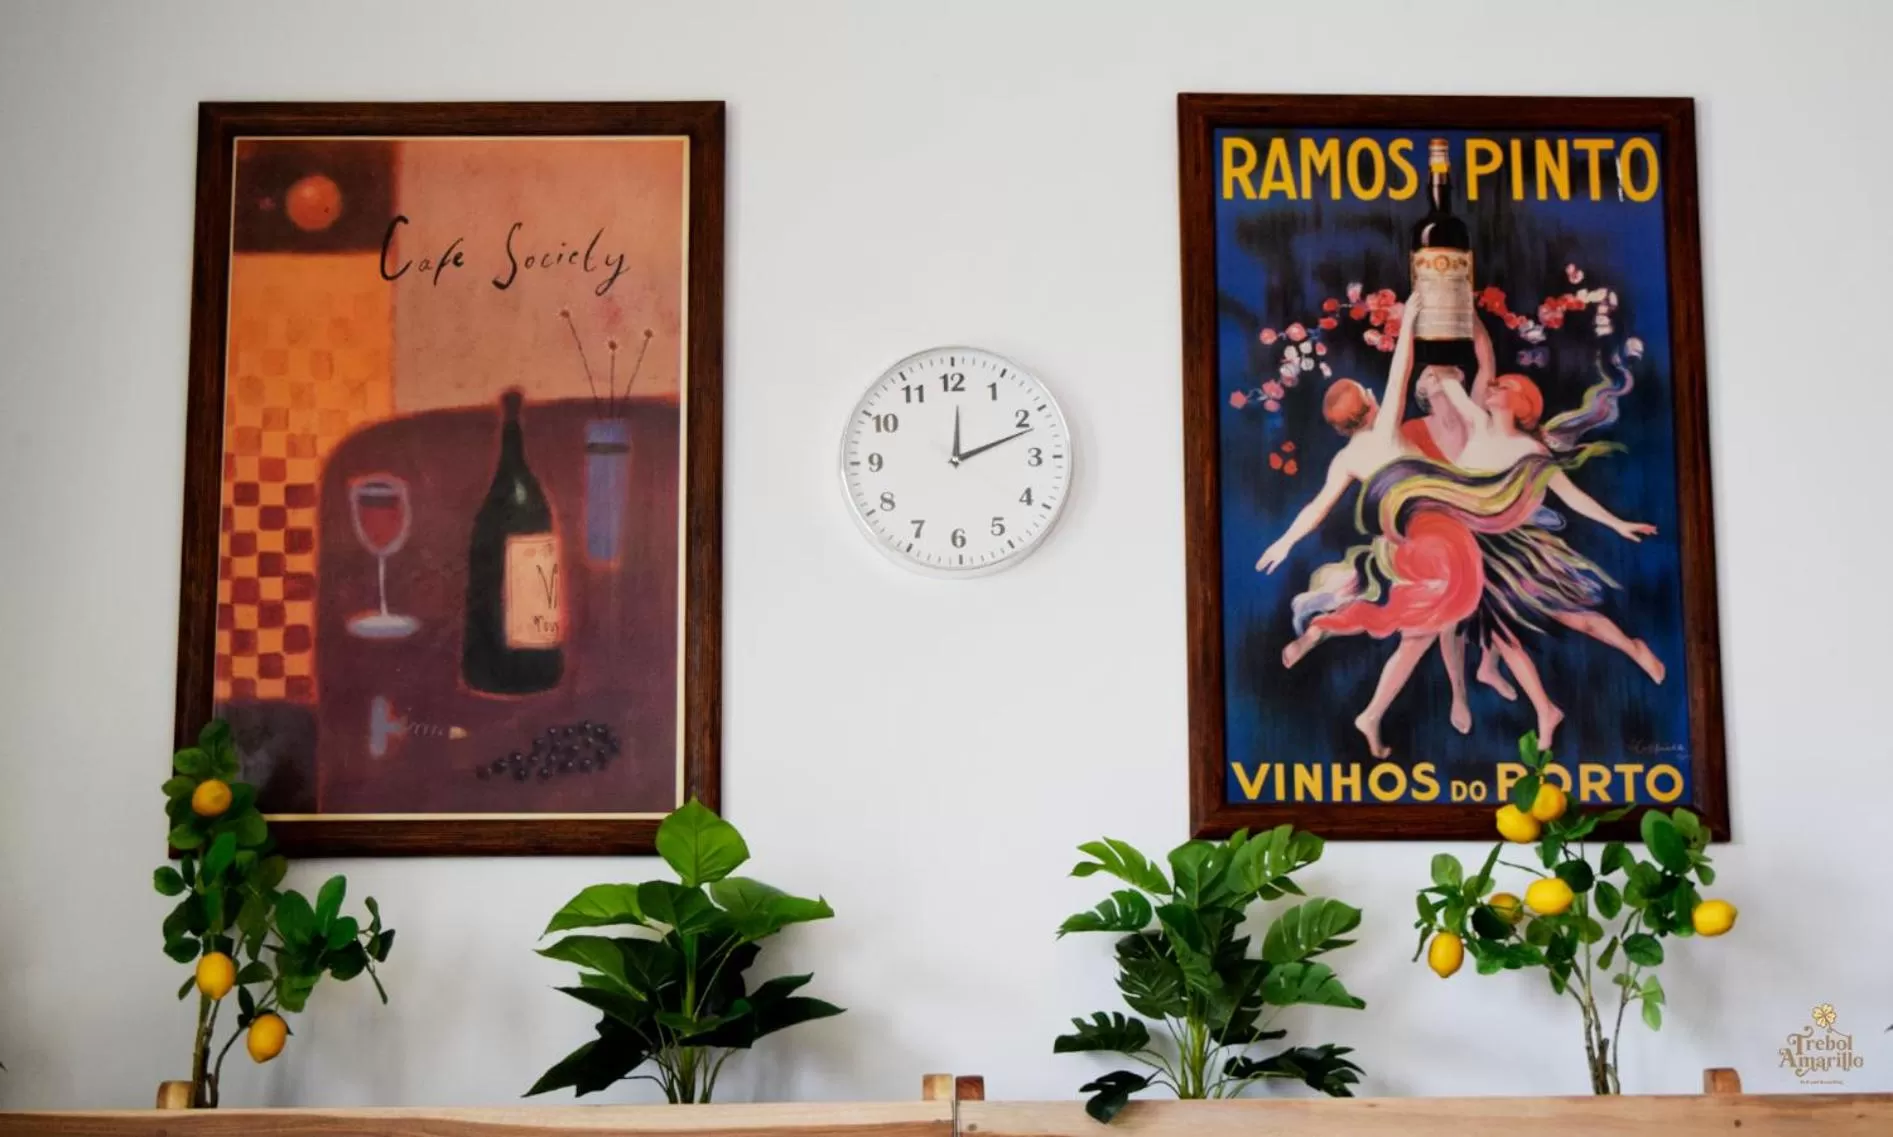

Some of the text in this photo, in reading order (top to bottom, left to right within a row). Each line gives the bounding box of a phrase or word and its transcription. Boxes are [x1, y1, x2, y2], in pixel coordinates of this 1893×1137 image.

[1222, 137, 1659, 202] RAMOS PINTO
[492, 222, 631, 296] Society
[939, 372, 966, 392] 12
[987, 382, 998, 401] 1
[902, 384, 925, 403] 11
[871, 413, 899, 433] 10
[1015, 409, 1030, 429] 2
[868, 452, 884, 473] 9
[1027, 447, 1043, 467] 3
[880, 492, 896, 512] 8
[1019, 487, 1034, 506] 4
[910, 519, 925, 539] 7
[990, 516, 1006, 536] 5
[951, 528, 967, 549] 6
[1232, 762, 1440, 802] VINHOS
[1451, 780, 1487, 802] DO
